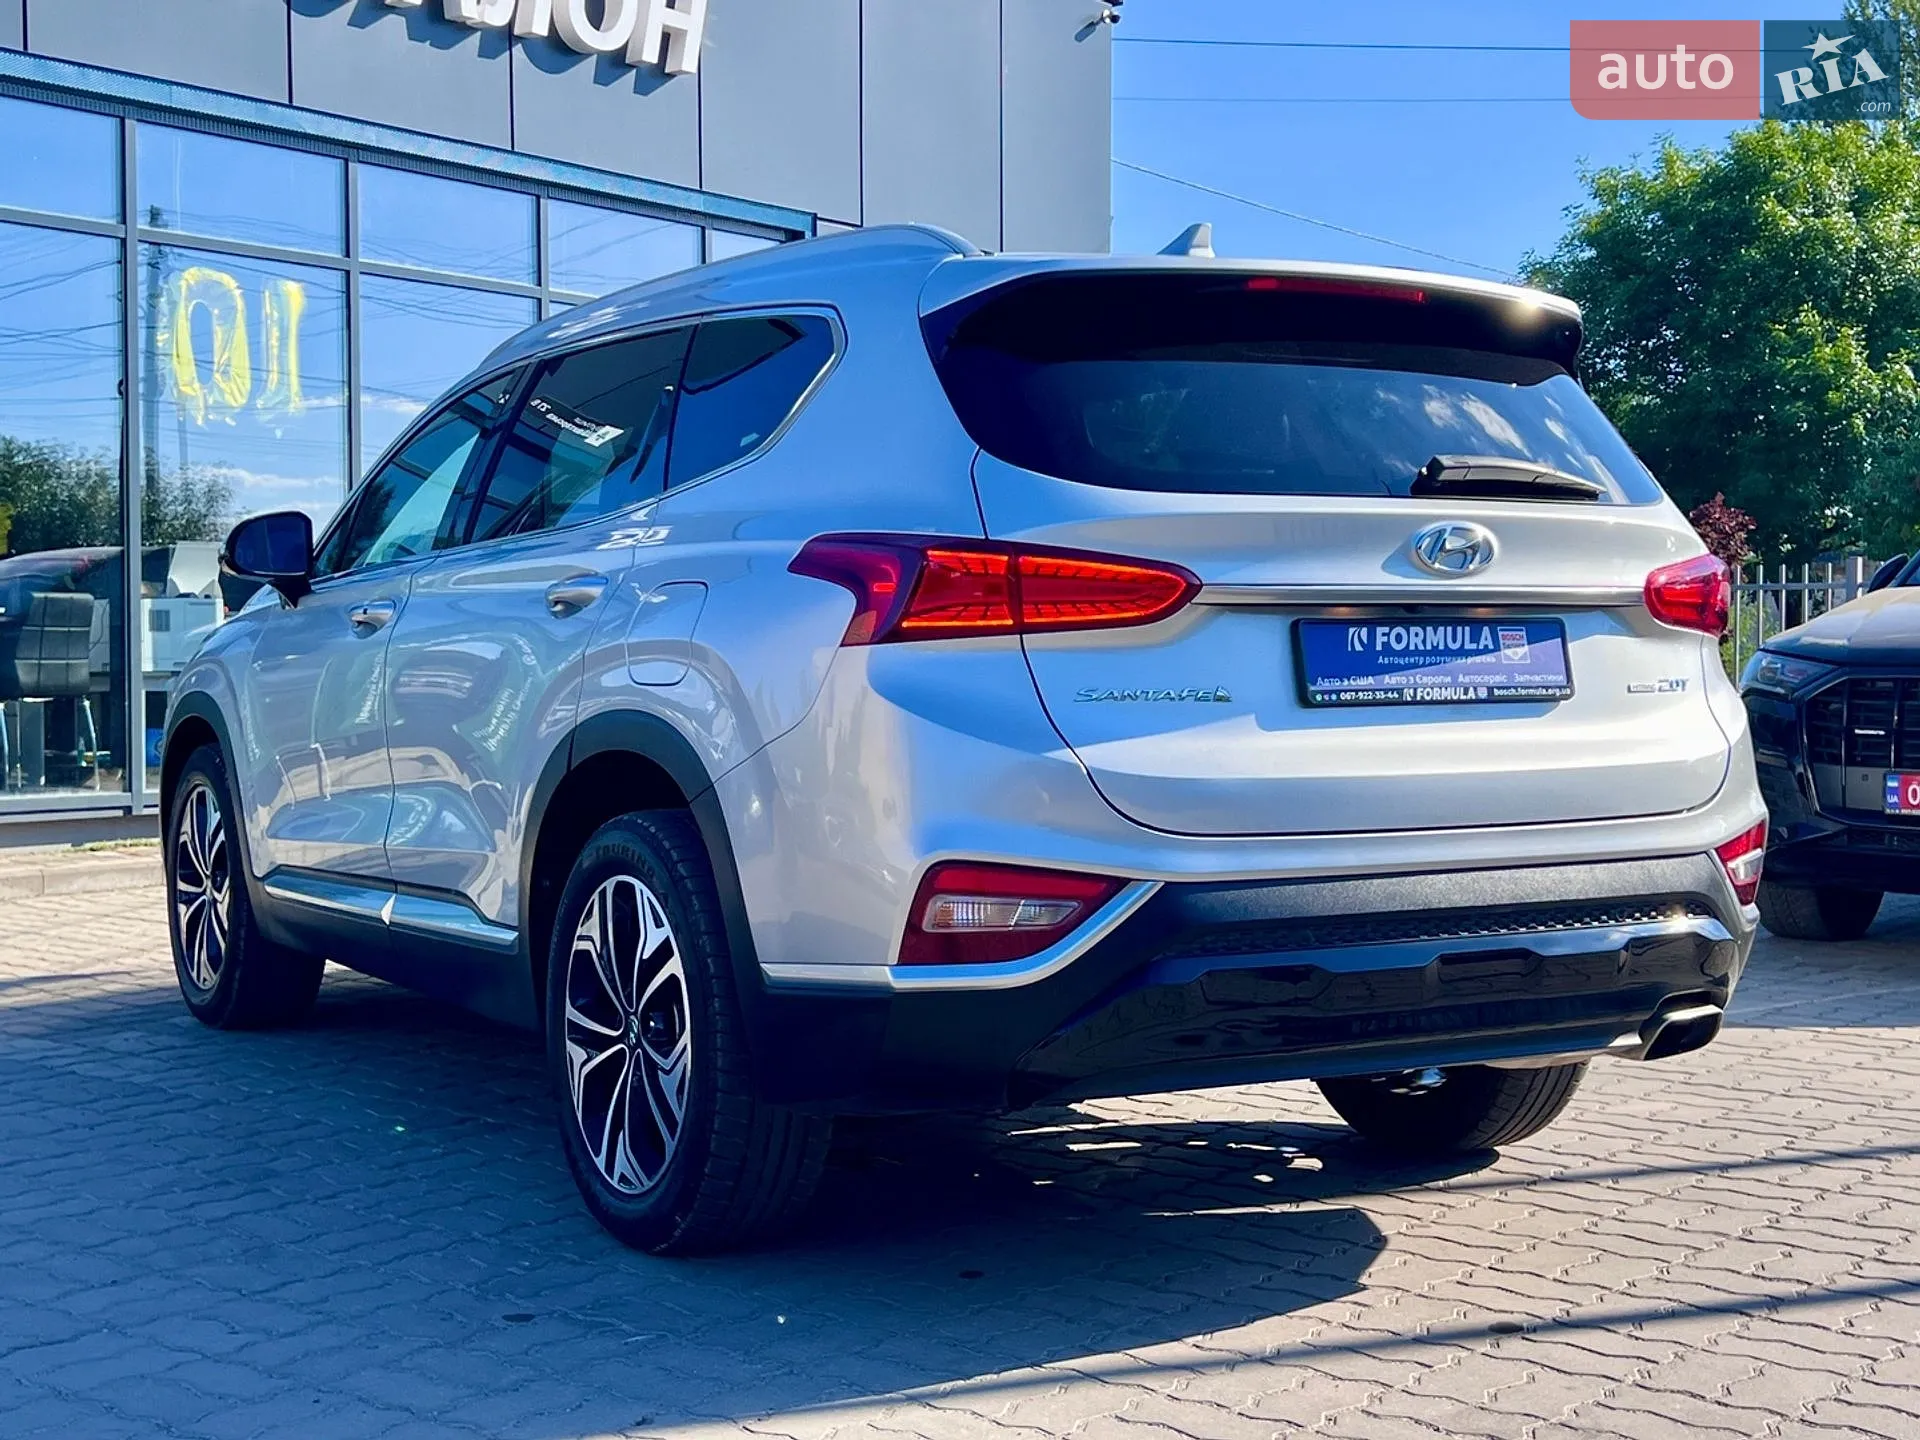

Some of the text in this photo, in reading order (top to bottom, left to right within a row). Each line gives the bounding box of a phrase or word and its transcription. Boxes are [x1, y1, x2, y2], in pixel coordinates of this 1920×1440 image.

[1375, 625, 1495, 651] FORMULA
[1377, 655, 1424, 666] Автоцентр
[1316, 677, 1341, 687] Авто
[1350, 676, 1375, 686] США
[1384, 675, 1407, 684] Авто
[1458, 673, 1508, 684] Автосервіс
[1416, 687, 1476, 700] FORMULA
[1887, 794, 1899, 803] UA
